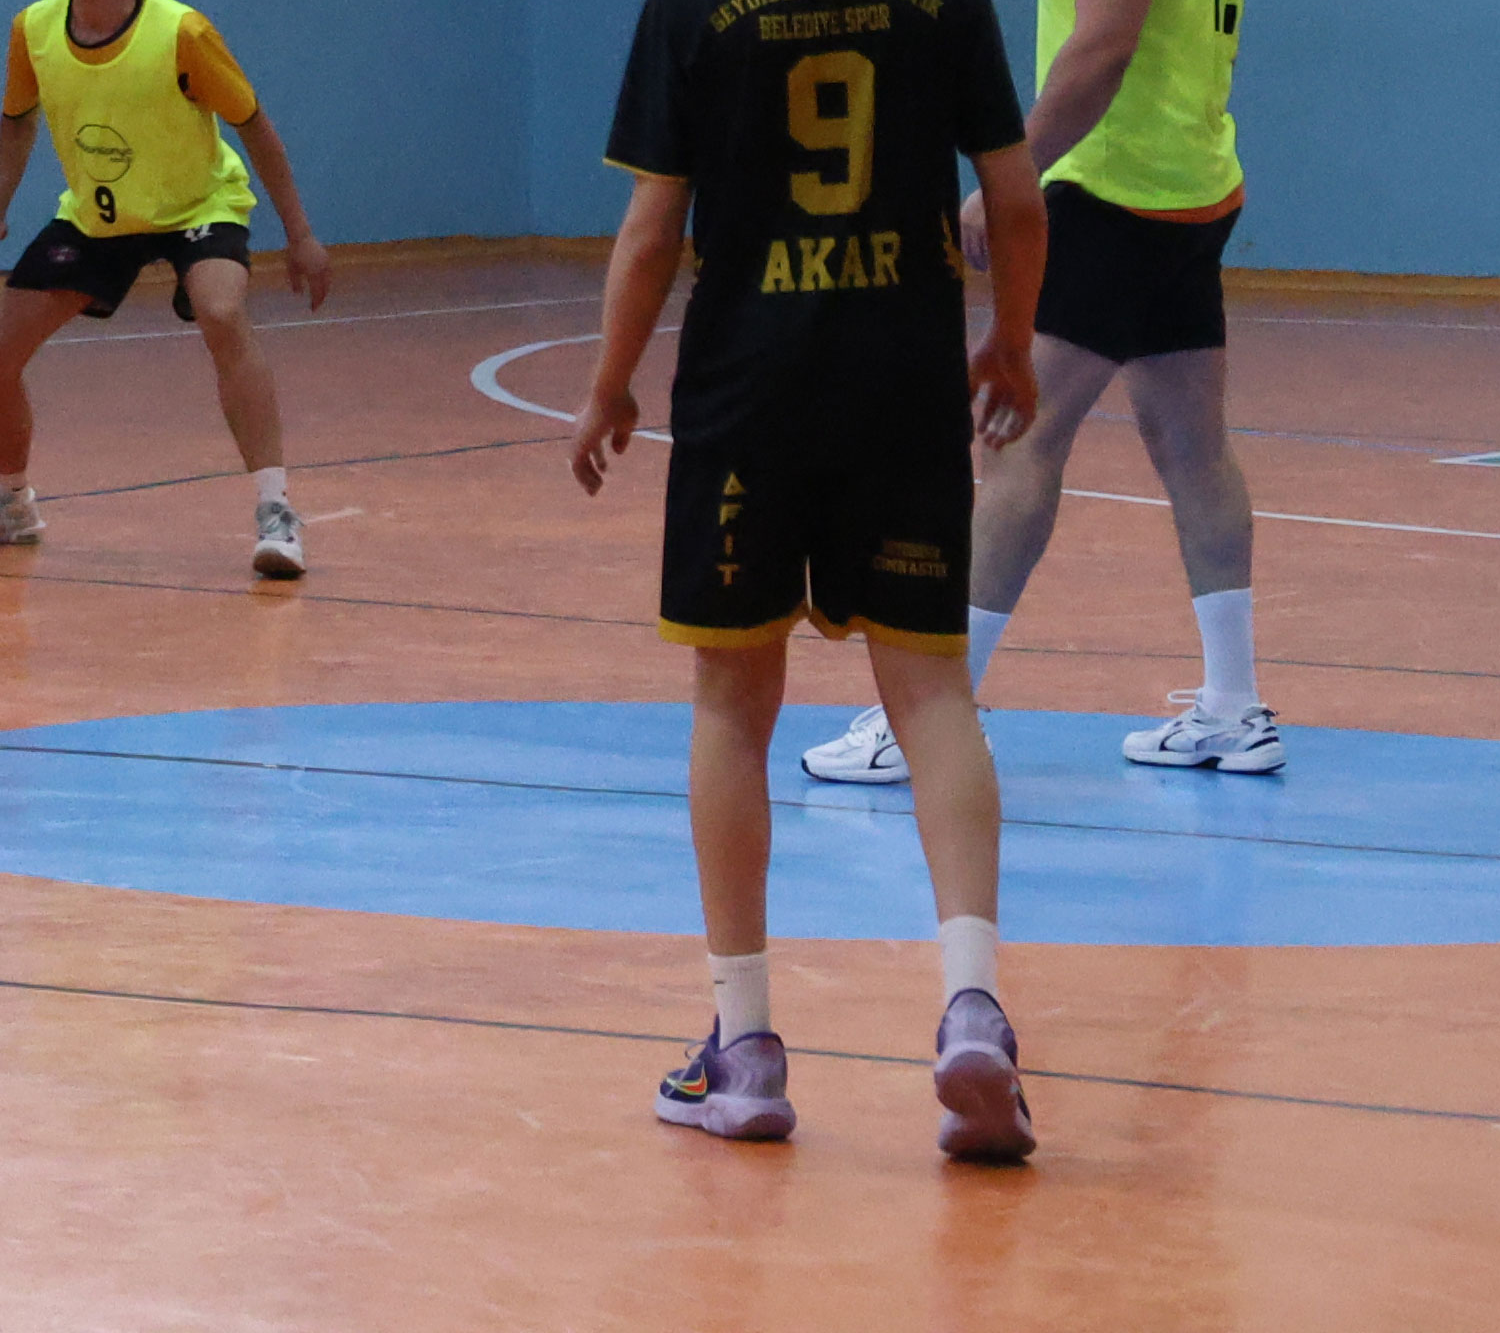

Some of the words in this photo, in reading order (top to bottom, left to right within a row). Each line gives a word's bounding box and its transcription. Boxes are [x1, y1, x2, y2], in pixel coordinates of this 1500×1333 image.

[787, 50, 876, 215] 9
[94, 185, 116, 224] 9
[760, 231, 900, 295] AKAR
